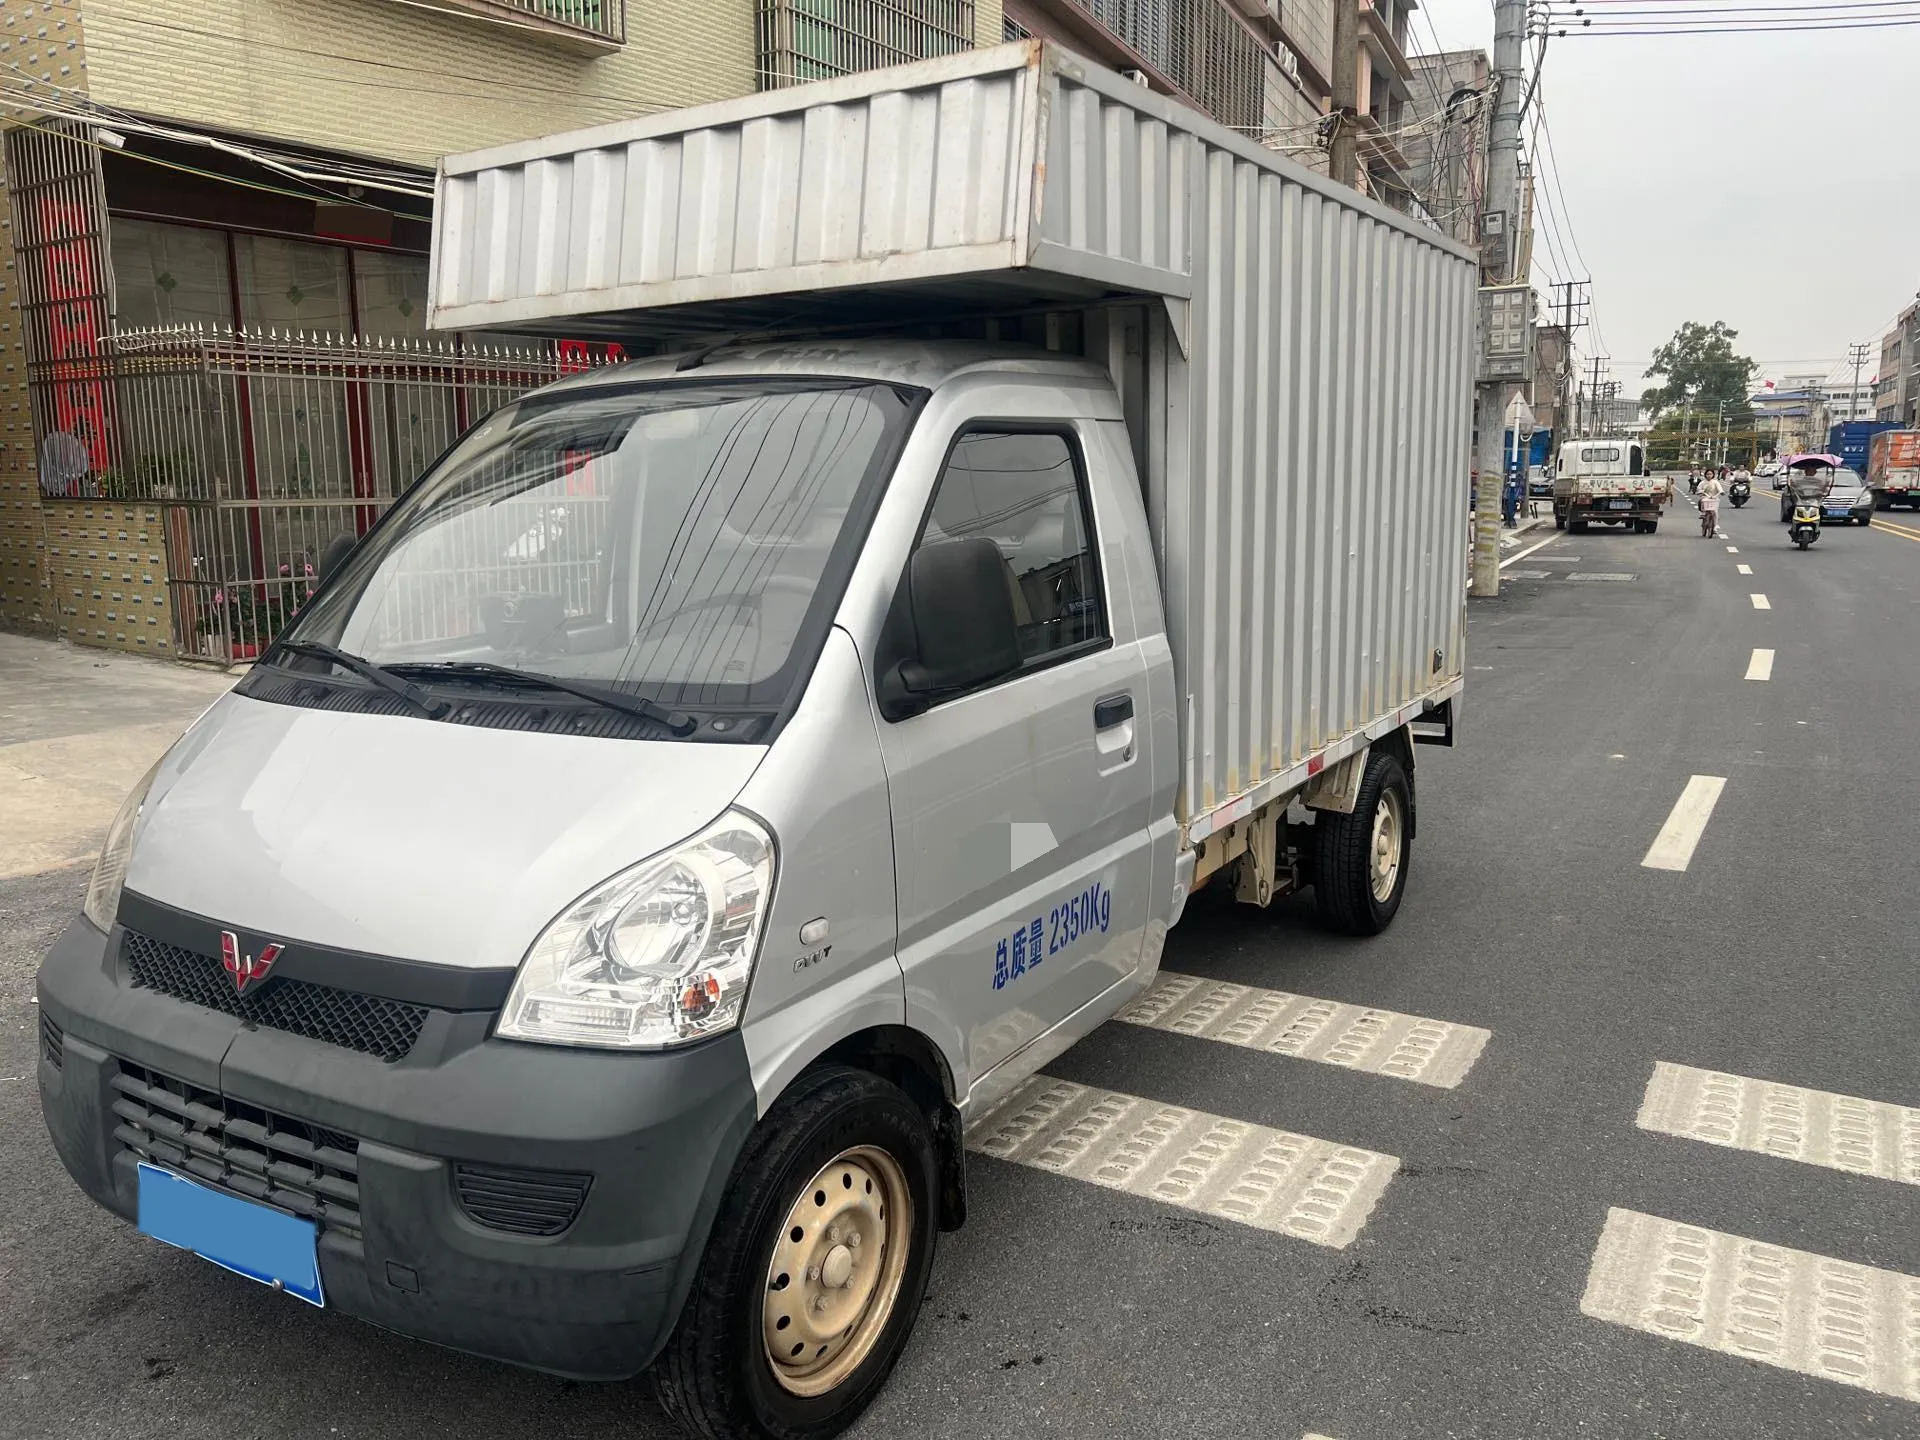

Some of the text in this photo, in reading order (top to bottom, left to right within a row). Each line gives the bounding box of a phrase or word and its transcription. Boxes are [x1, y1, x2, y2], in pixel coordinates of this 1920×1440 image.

[992, 880, 1111, 990] 总质量 2350Kg
